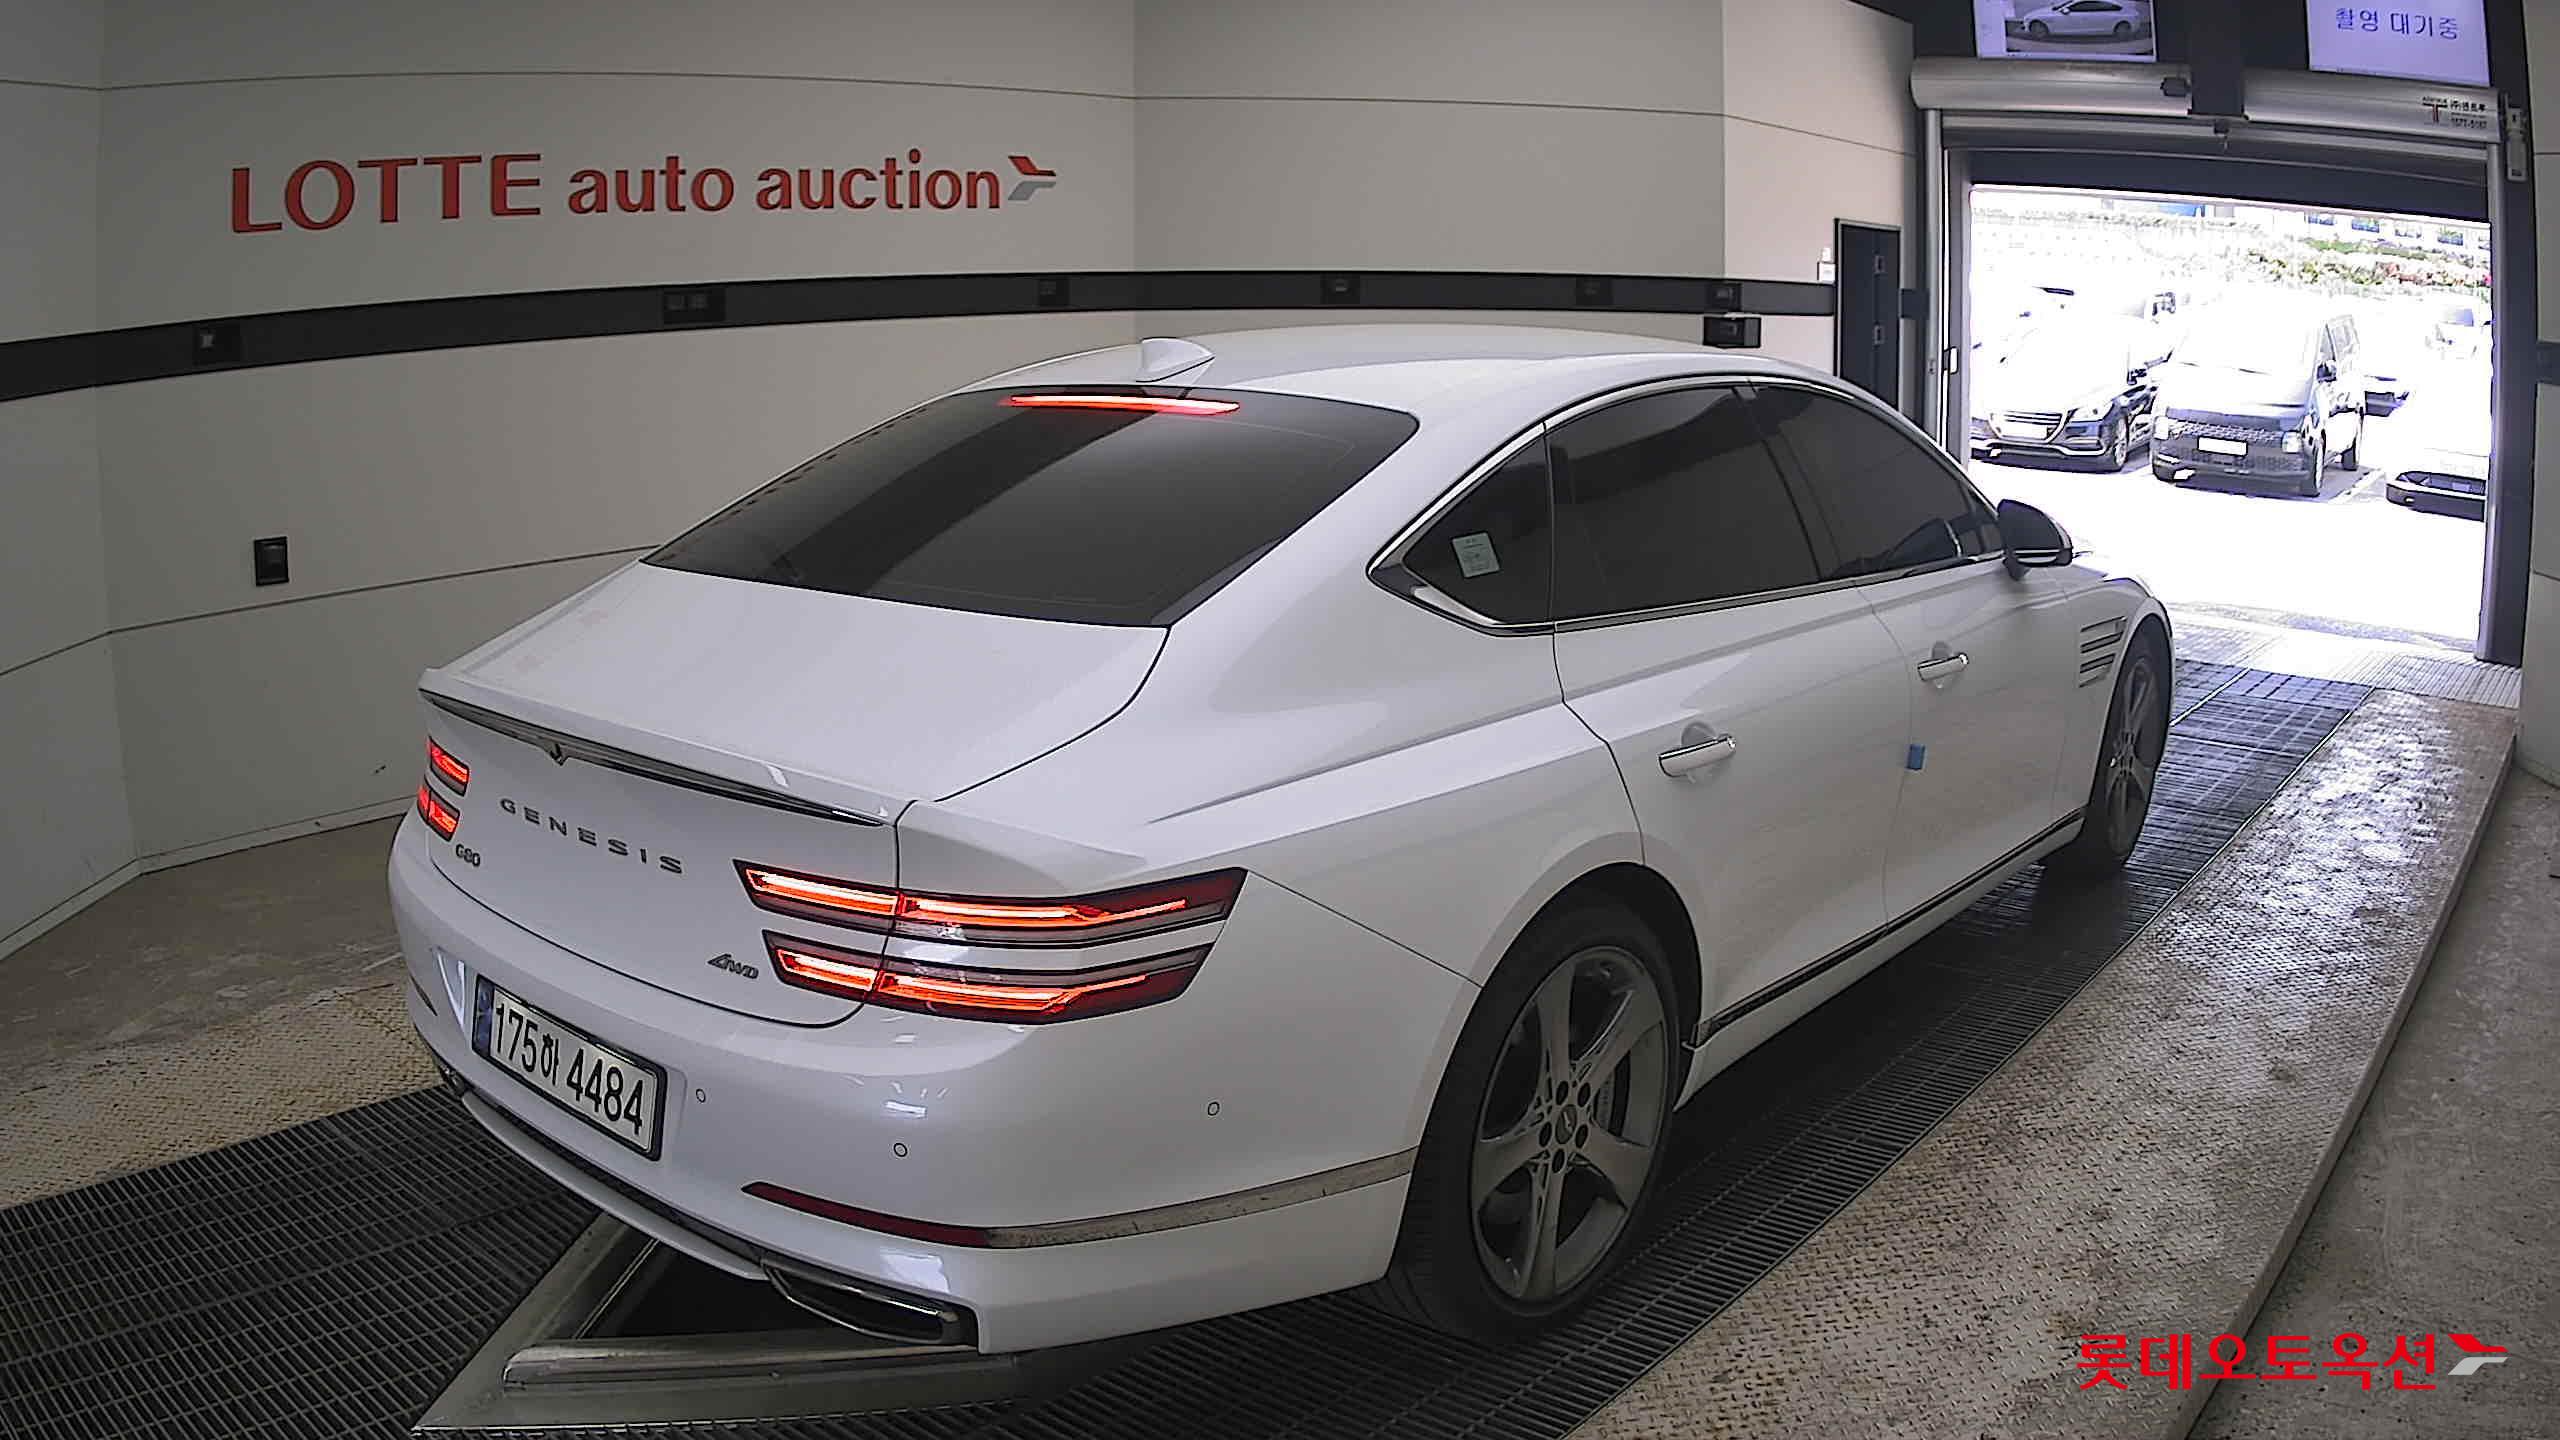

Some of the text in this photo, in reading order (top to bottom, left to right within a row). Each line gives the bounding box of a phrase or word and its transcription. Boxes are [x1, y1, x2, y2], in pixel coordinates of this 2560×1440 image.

[2336, 8, 2457, 40] 촬영 대기중
[231, 148, 1002, 234] LOTTE auto auction
[455, 843, 481, 867] G80
[500, 798, 683, 874] GENESIS
[495, 1003, 643, 1136] 175하 4484
